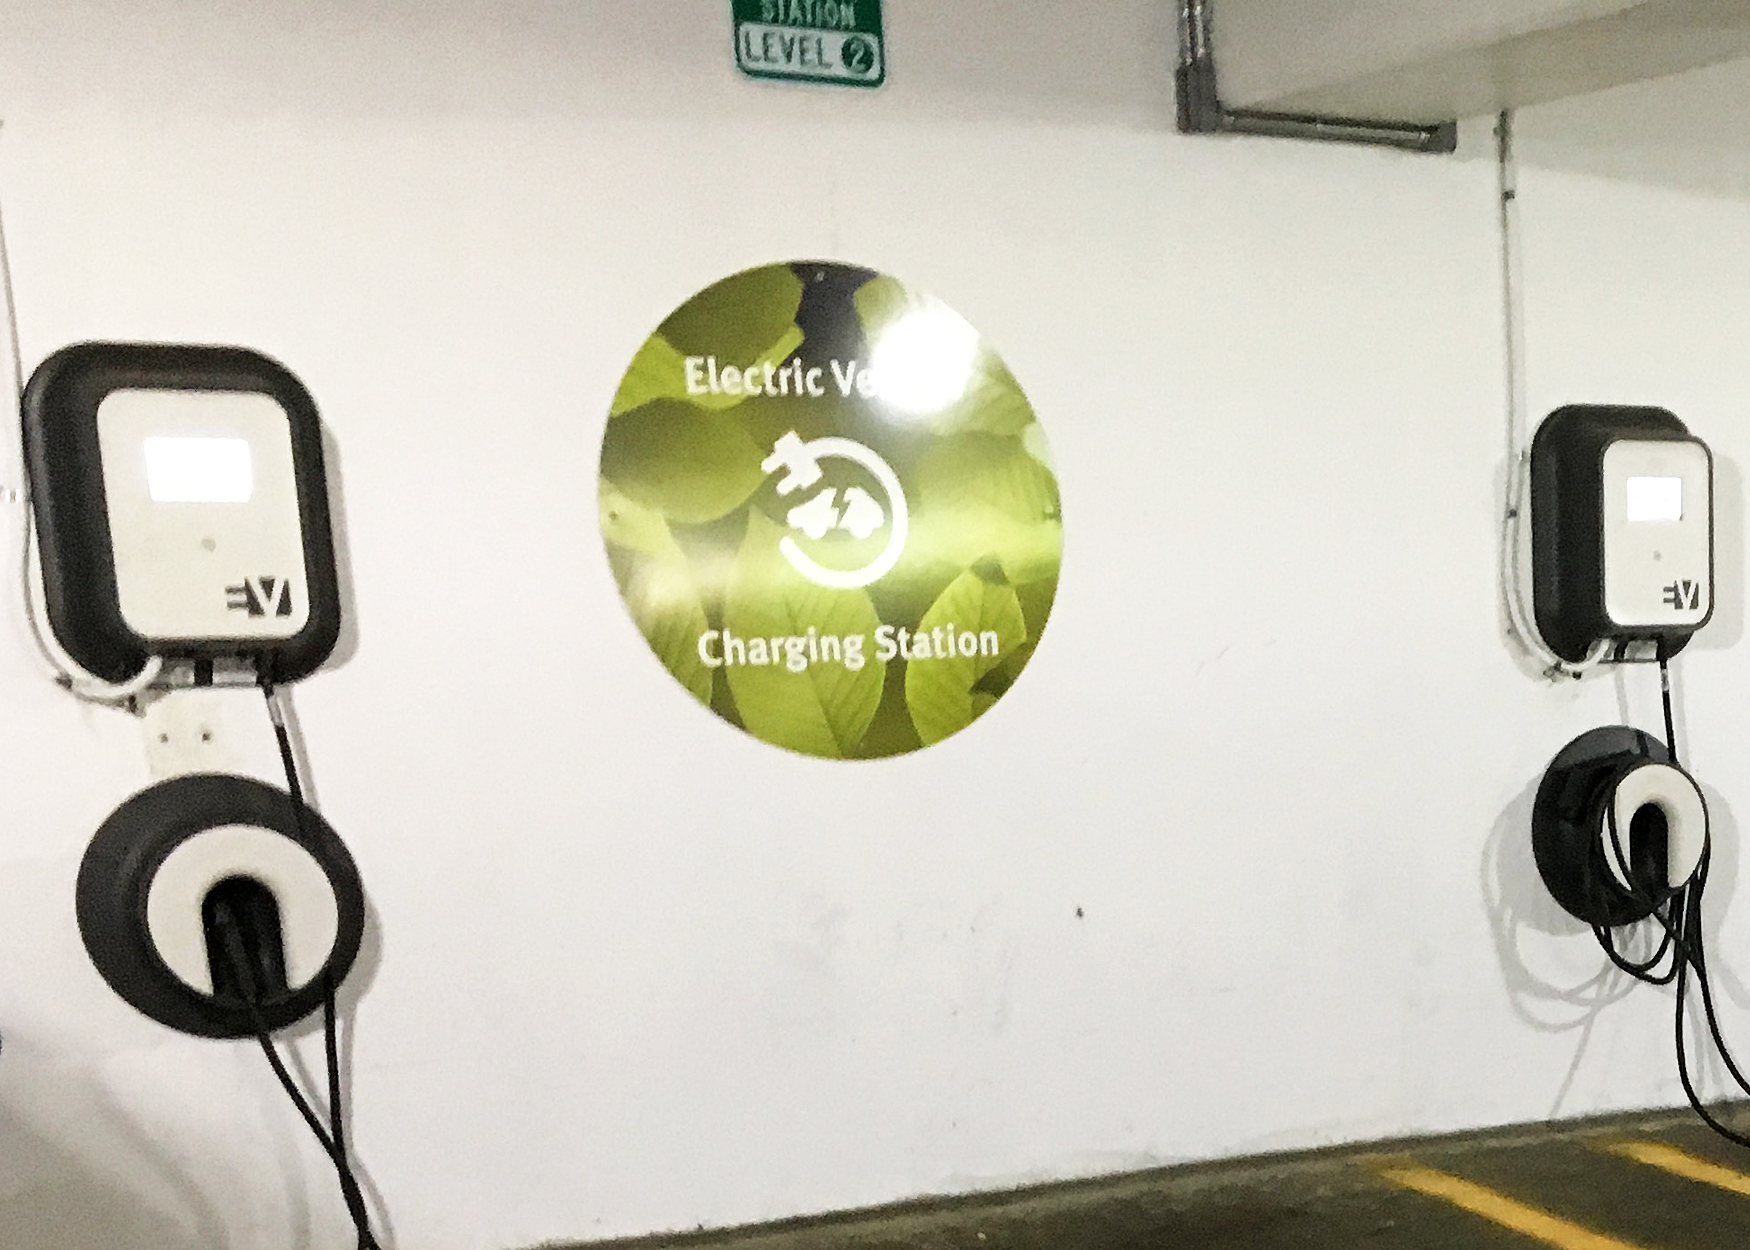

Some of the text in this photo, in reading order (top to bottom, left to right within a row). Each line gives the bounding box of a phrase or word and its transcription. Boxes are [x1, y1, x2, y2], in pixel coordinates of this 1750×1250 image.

[744, 31, 833, 69] LEVEL
[684, 355, 824, 396] Electric
[697, 622, 1000, 673] Charging Station
